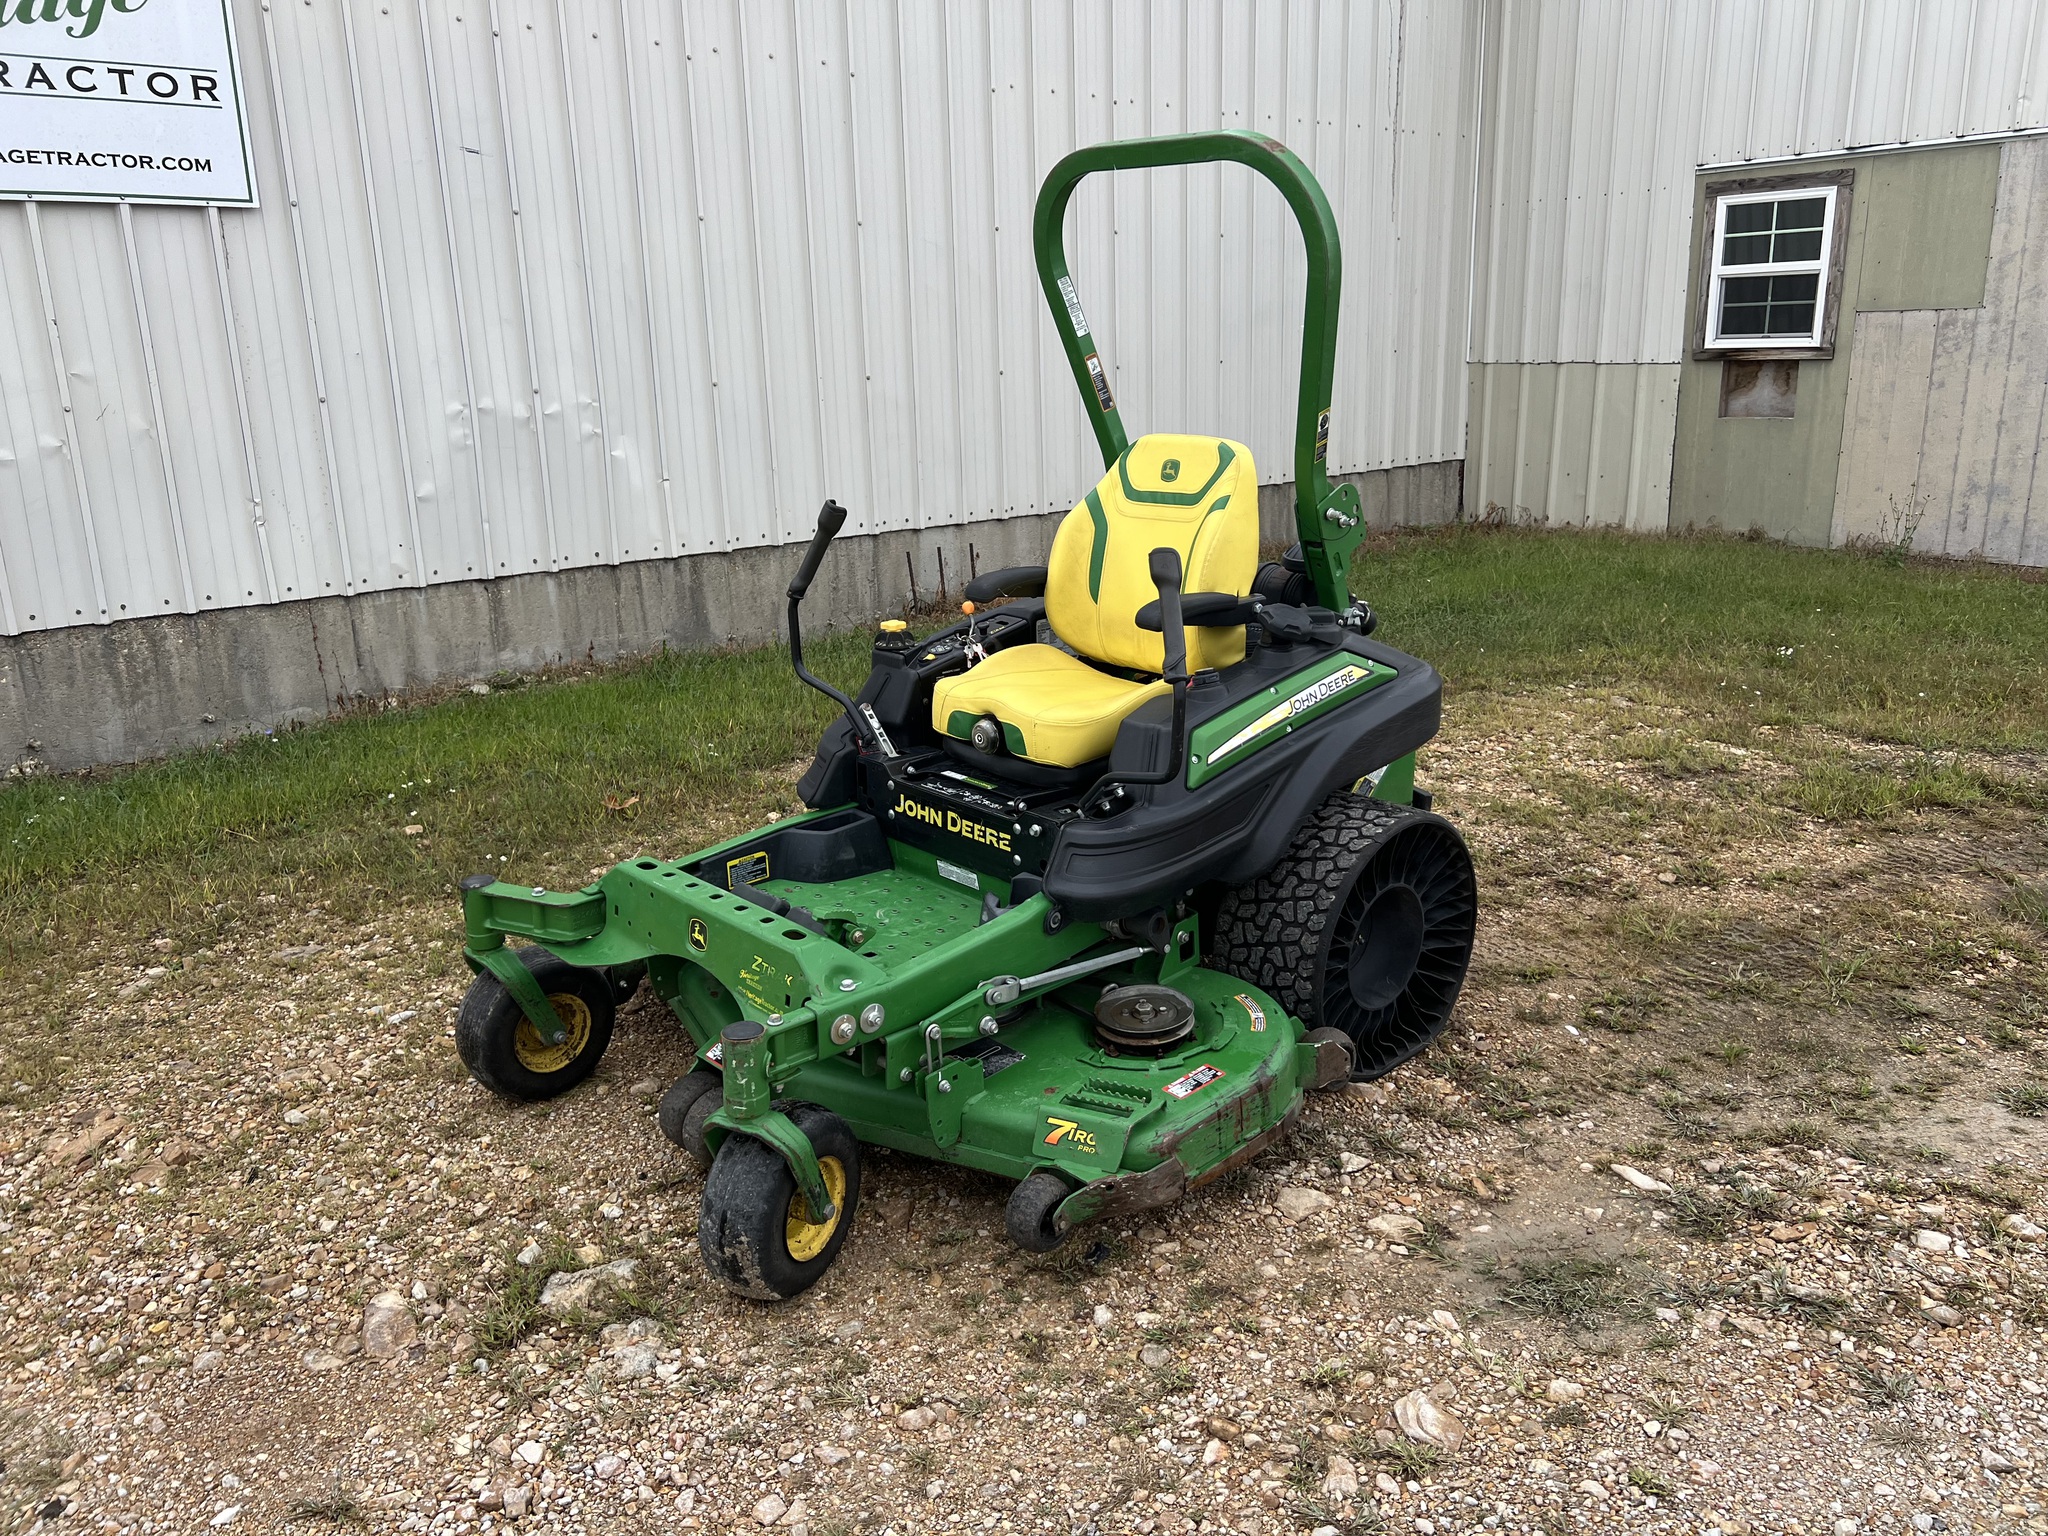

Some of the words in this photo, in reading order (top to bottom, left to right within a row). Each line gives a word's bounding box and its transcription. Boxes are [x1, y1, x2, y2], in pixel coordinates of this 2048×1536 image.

[1288, 691, 1318, 715] JOHN
[1319, 671, 1355, 697] DEERE
[894, 793, 943, 828] JOHN
[947, 810, 1012, 852] DEERE
[751, 954, 794, 987] ZTRK
[1077, 1144, 1096, 1154] PRO
